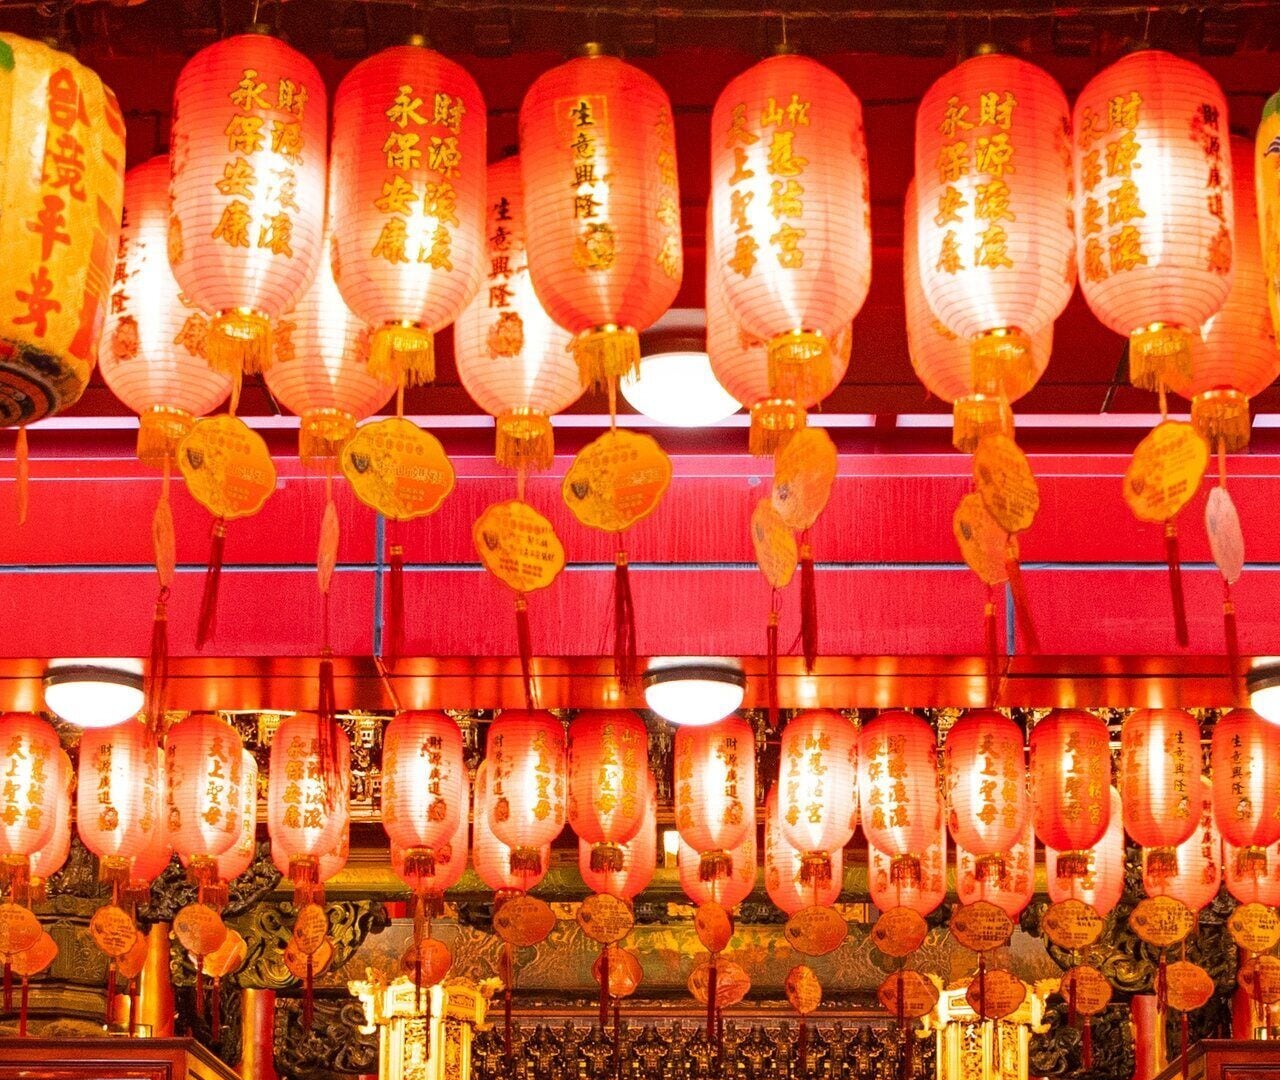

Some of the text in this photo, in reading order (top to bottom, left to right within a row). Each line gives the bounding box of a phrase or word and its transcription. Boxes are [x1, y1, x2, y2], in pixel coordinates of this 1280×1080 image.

[12, 67, 90, 337] 合境平安
[212, 69, 274, 248] 永保安康
[371, 85, 427, 265] 永保安康
[569, 102, 600, 221] 生意興隆
[488, 198, 513, 310] 生意興隆
[1173, 731, 1187, 793] 生意興隆
[1230, 734, 1245, 796] 生意興隆
